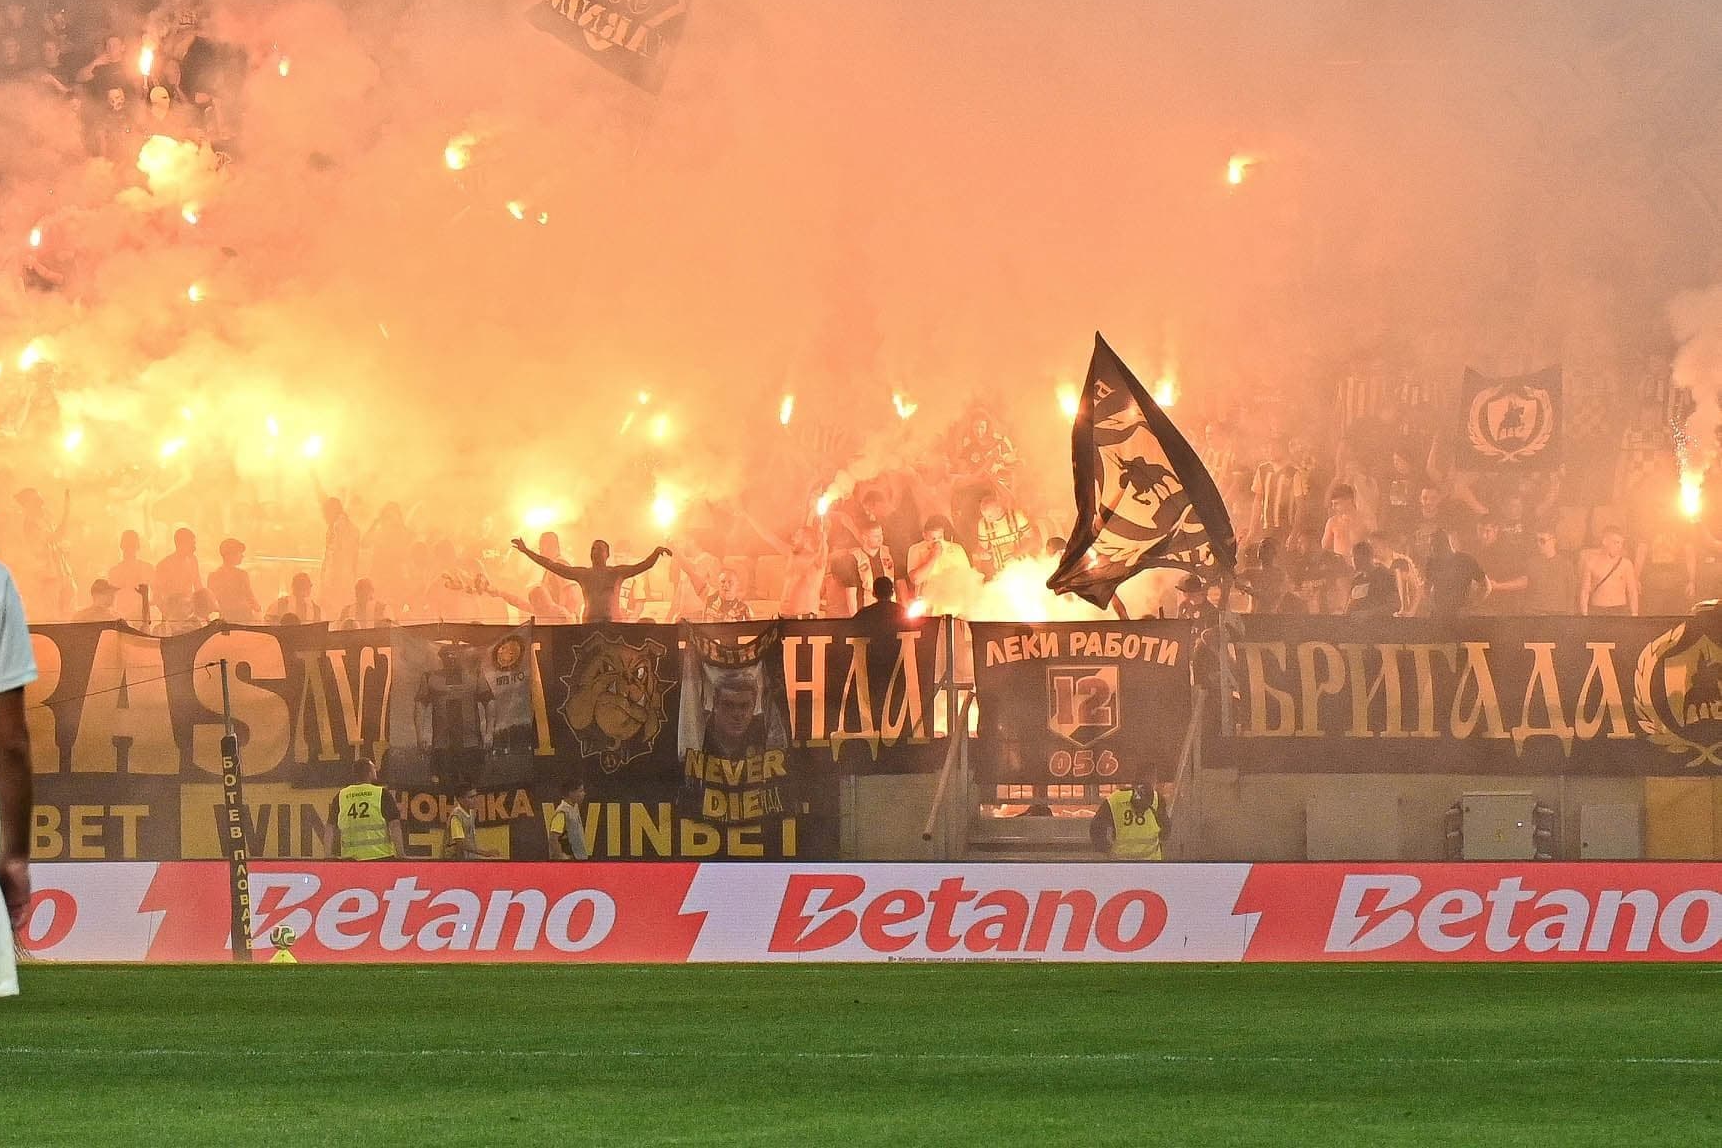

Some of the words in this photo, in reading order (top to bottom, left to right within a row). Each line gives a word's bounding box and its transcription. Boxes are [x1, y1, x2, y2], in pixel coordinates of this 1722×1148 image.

[985, 632, 1060, 667] ЛЕКИ
[1069, 632, 1179, 666] РАБОТИ
[1052, 675, 1113, 726] 12
[1235, 640, 1635, 758] БРИГАДА
[684, 749, 788, 785] NEVER
[1048, 750, 1119, 778] 056
[223, 756, 244, 839] БОТЕВ
[347, 801, 371, 820] 42
[702, 788, 765, 822] DIE
[224, 872, 617, 953] Betano
[767, 874, 1169, 953] Betano
[1324, 874, 1722, 953] Betano
